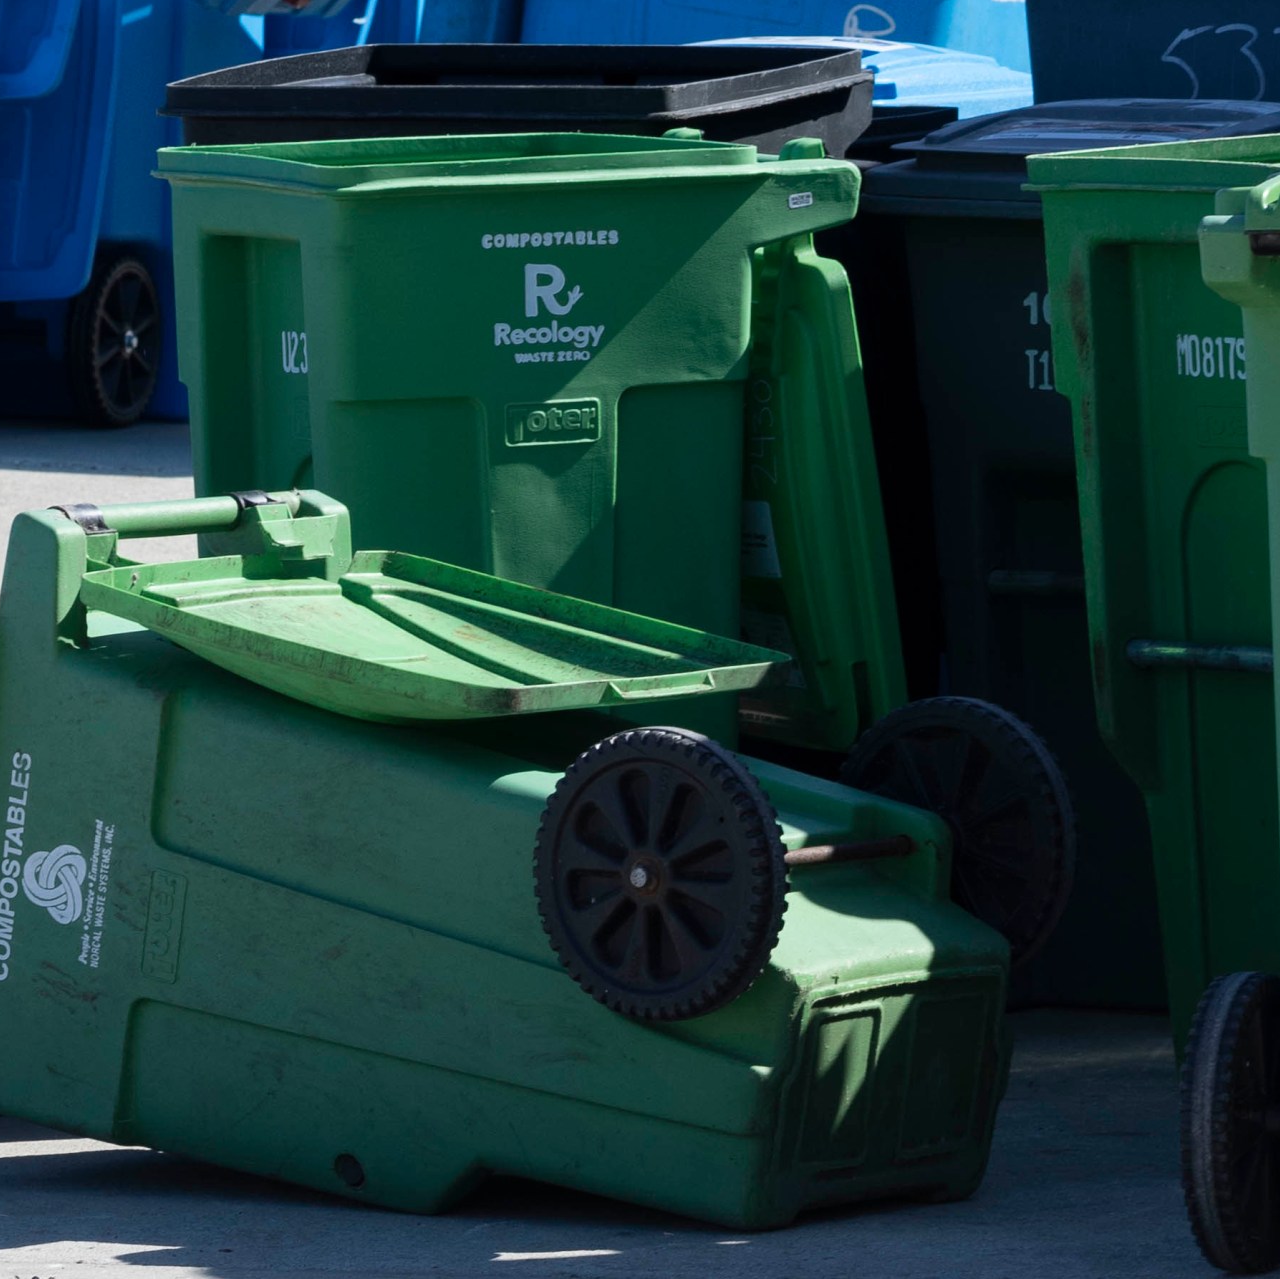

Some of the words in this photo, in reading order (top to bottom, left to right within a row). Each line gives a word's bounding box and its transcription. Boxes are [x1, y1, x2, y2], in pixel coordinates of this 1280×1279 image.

[481, 229, 619, 249] COMPOSTABLES
[493, 321, 604, 348] Recology
[515, 350, 554, 364] WASTE
[557, 348, 590, 362] ZERO
[104, 823, 116, 844] INC.
[88, 818, 104, 882] Environment
[83, 888, 96, 925] Service
[94, 895, 107, 927] WASTE
[78, 932, 91, 965] People
[90, 930, 103, 968] NORCAL
